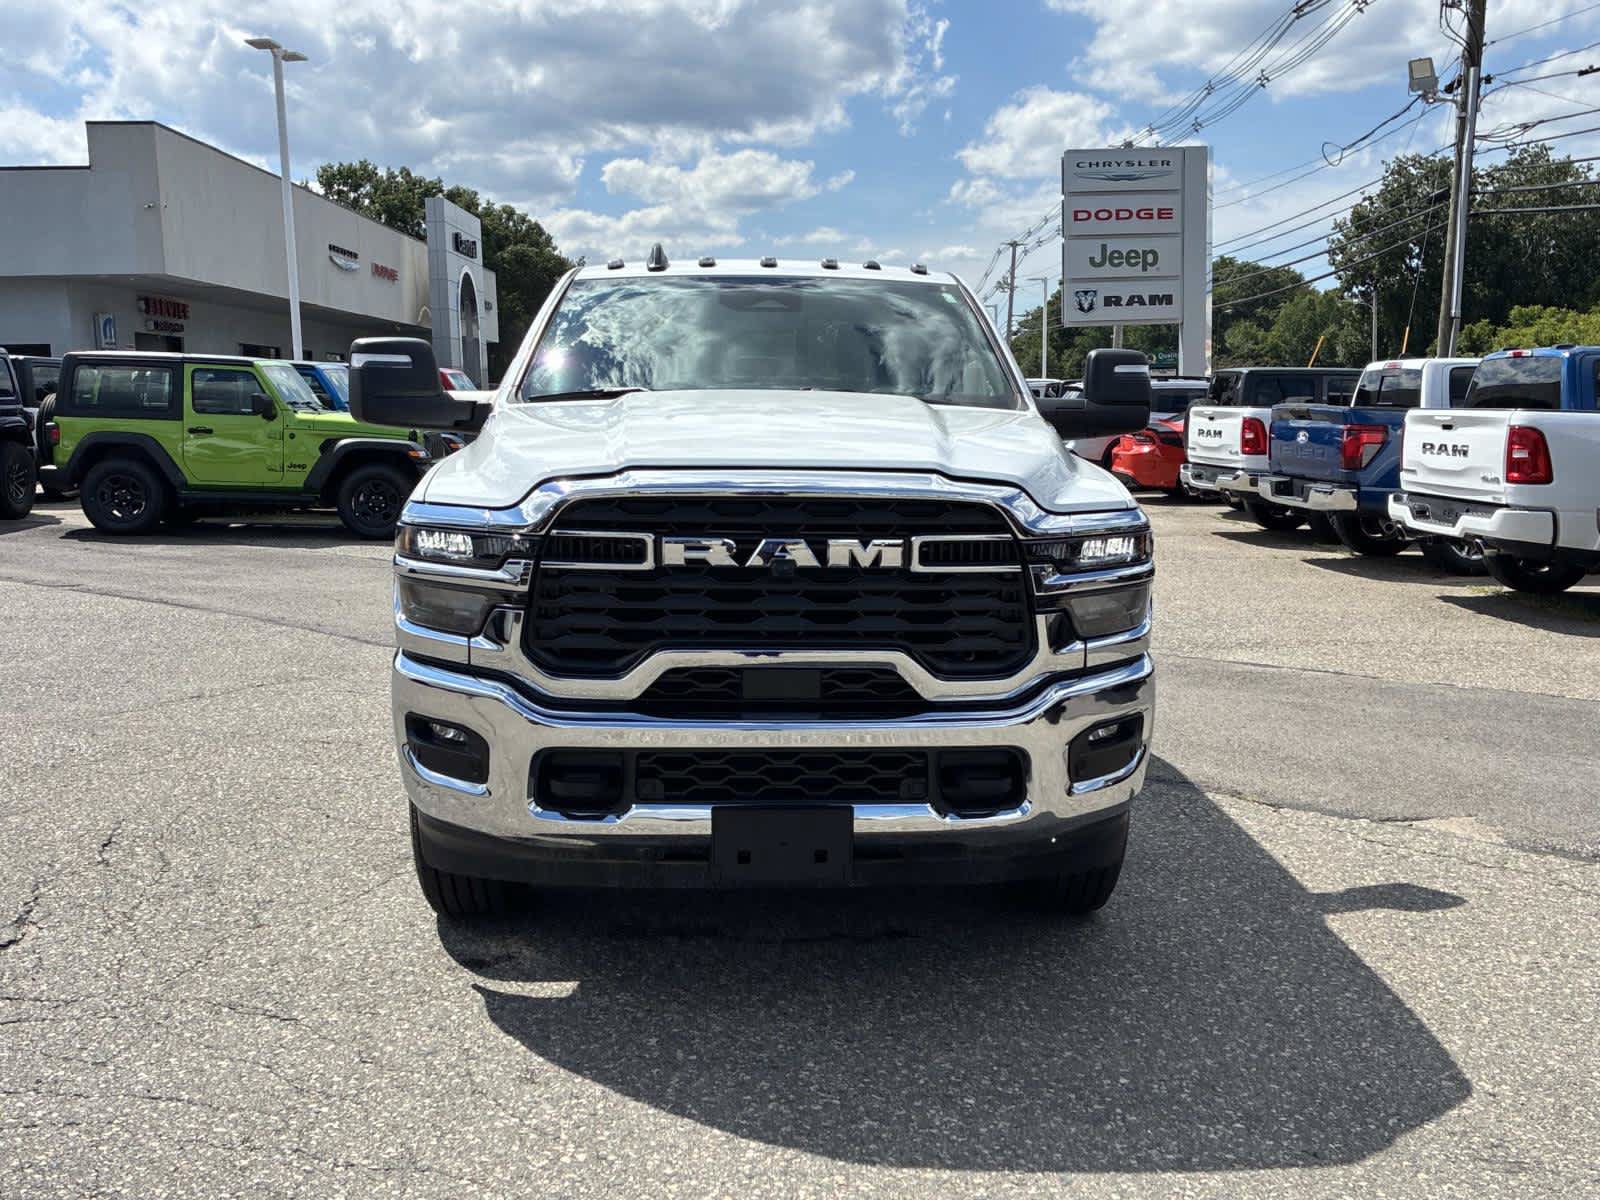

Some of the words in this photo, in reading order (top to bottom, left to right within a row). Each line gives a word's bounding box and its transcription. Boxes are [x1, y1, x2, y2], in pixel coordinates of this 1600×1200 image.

[1076, 159, 1171, 168] CHRYSLER
[1073, 208, 1174, 222] DODGE
[1088, 243, 1159, 273] Jeep
[1103, 294, 1174, 308] RAM
[1197, 428, 1223, 440] RAM
[1421, 442, 1470, 458] RAM
[661, 536, 905, 567] RAM
